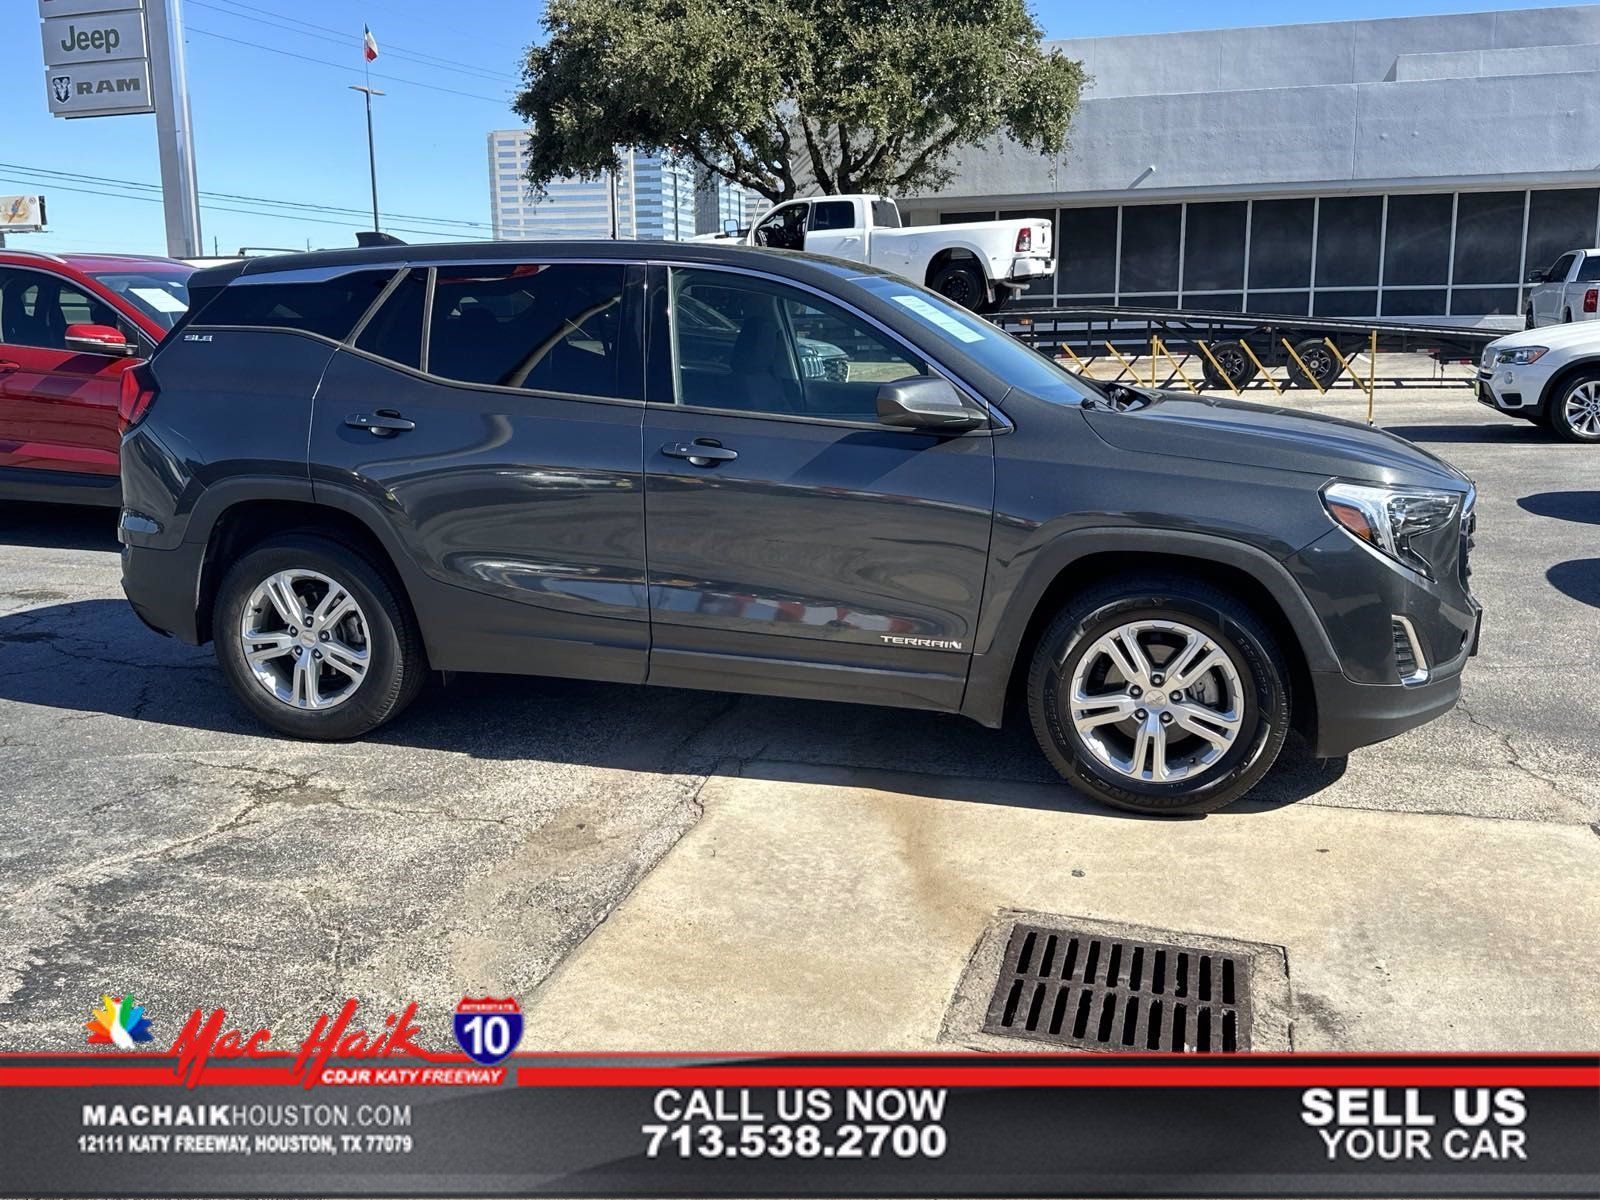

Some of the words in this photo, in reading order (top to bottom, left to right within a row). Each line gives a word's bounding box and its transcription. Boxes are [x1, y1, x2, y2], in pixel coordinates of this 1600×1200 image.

[61, 25, 120, 54] Jeep
[76, 78, 141, 95] RAM
[880, 635, 962, 649] TERRAIN
